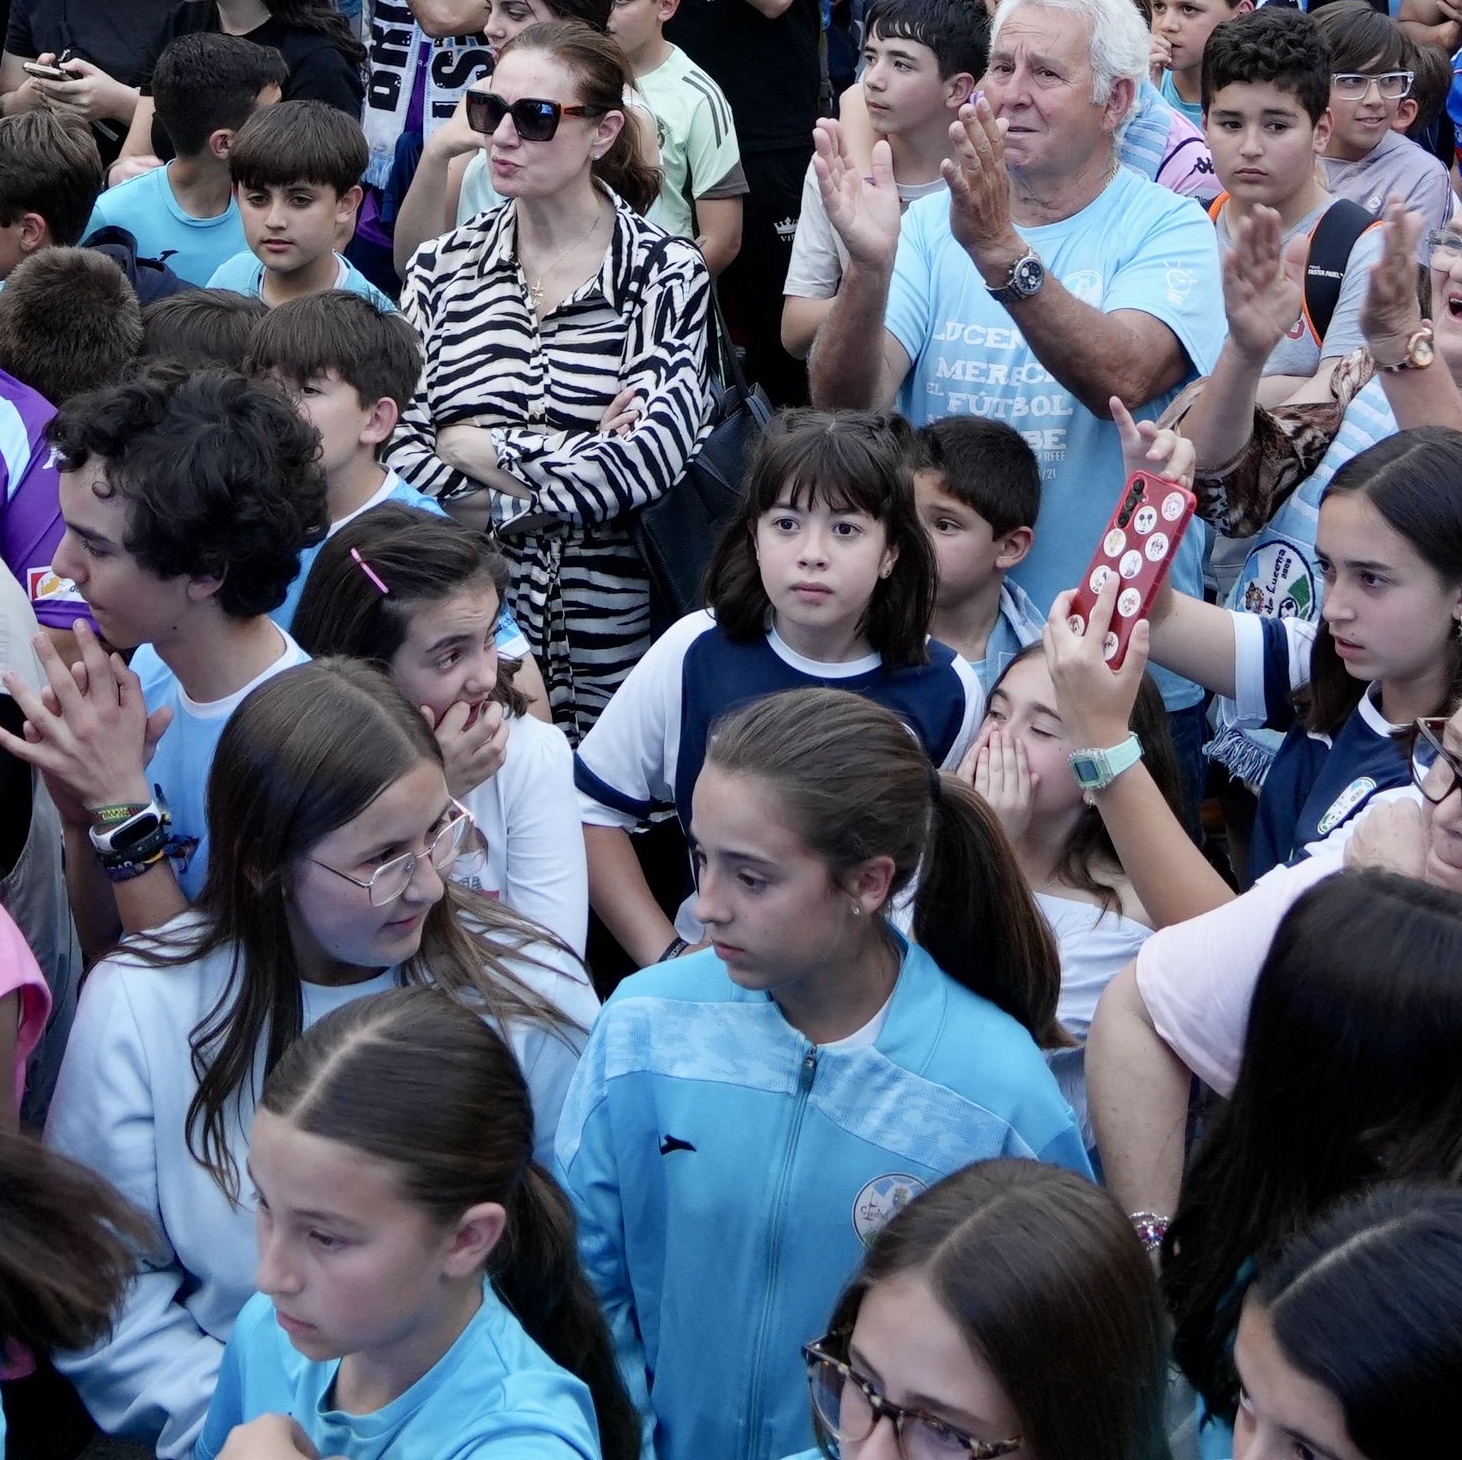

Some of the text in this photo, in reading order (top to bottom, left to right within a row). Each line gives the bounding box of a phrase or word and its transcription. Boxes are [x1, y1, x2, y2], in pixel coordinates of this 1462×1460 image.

[932, 320, 1027, 350] LUCEN
[1264, 549, 1287, 614] de Lucena
[1281, 558, 1292, 579] 2008
